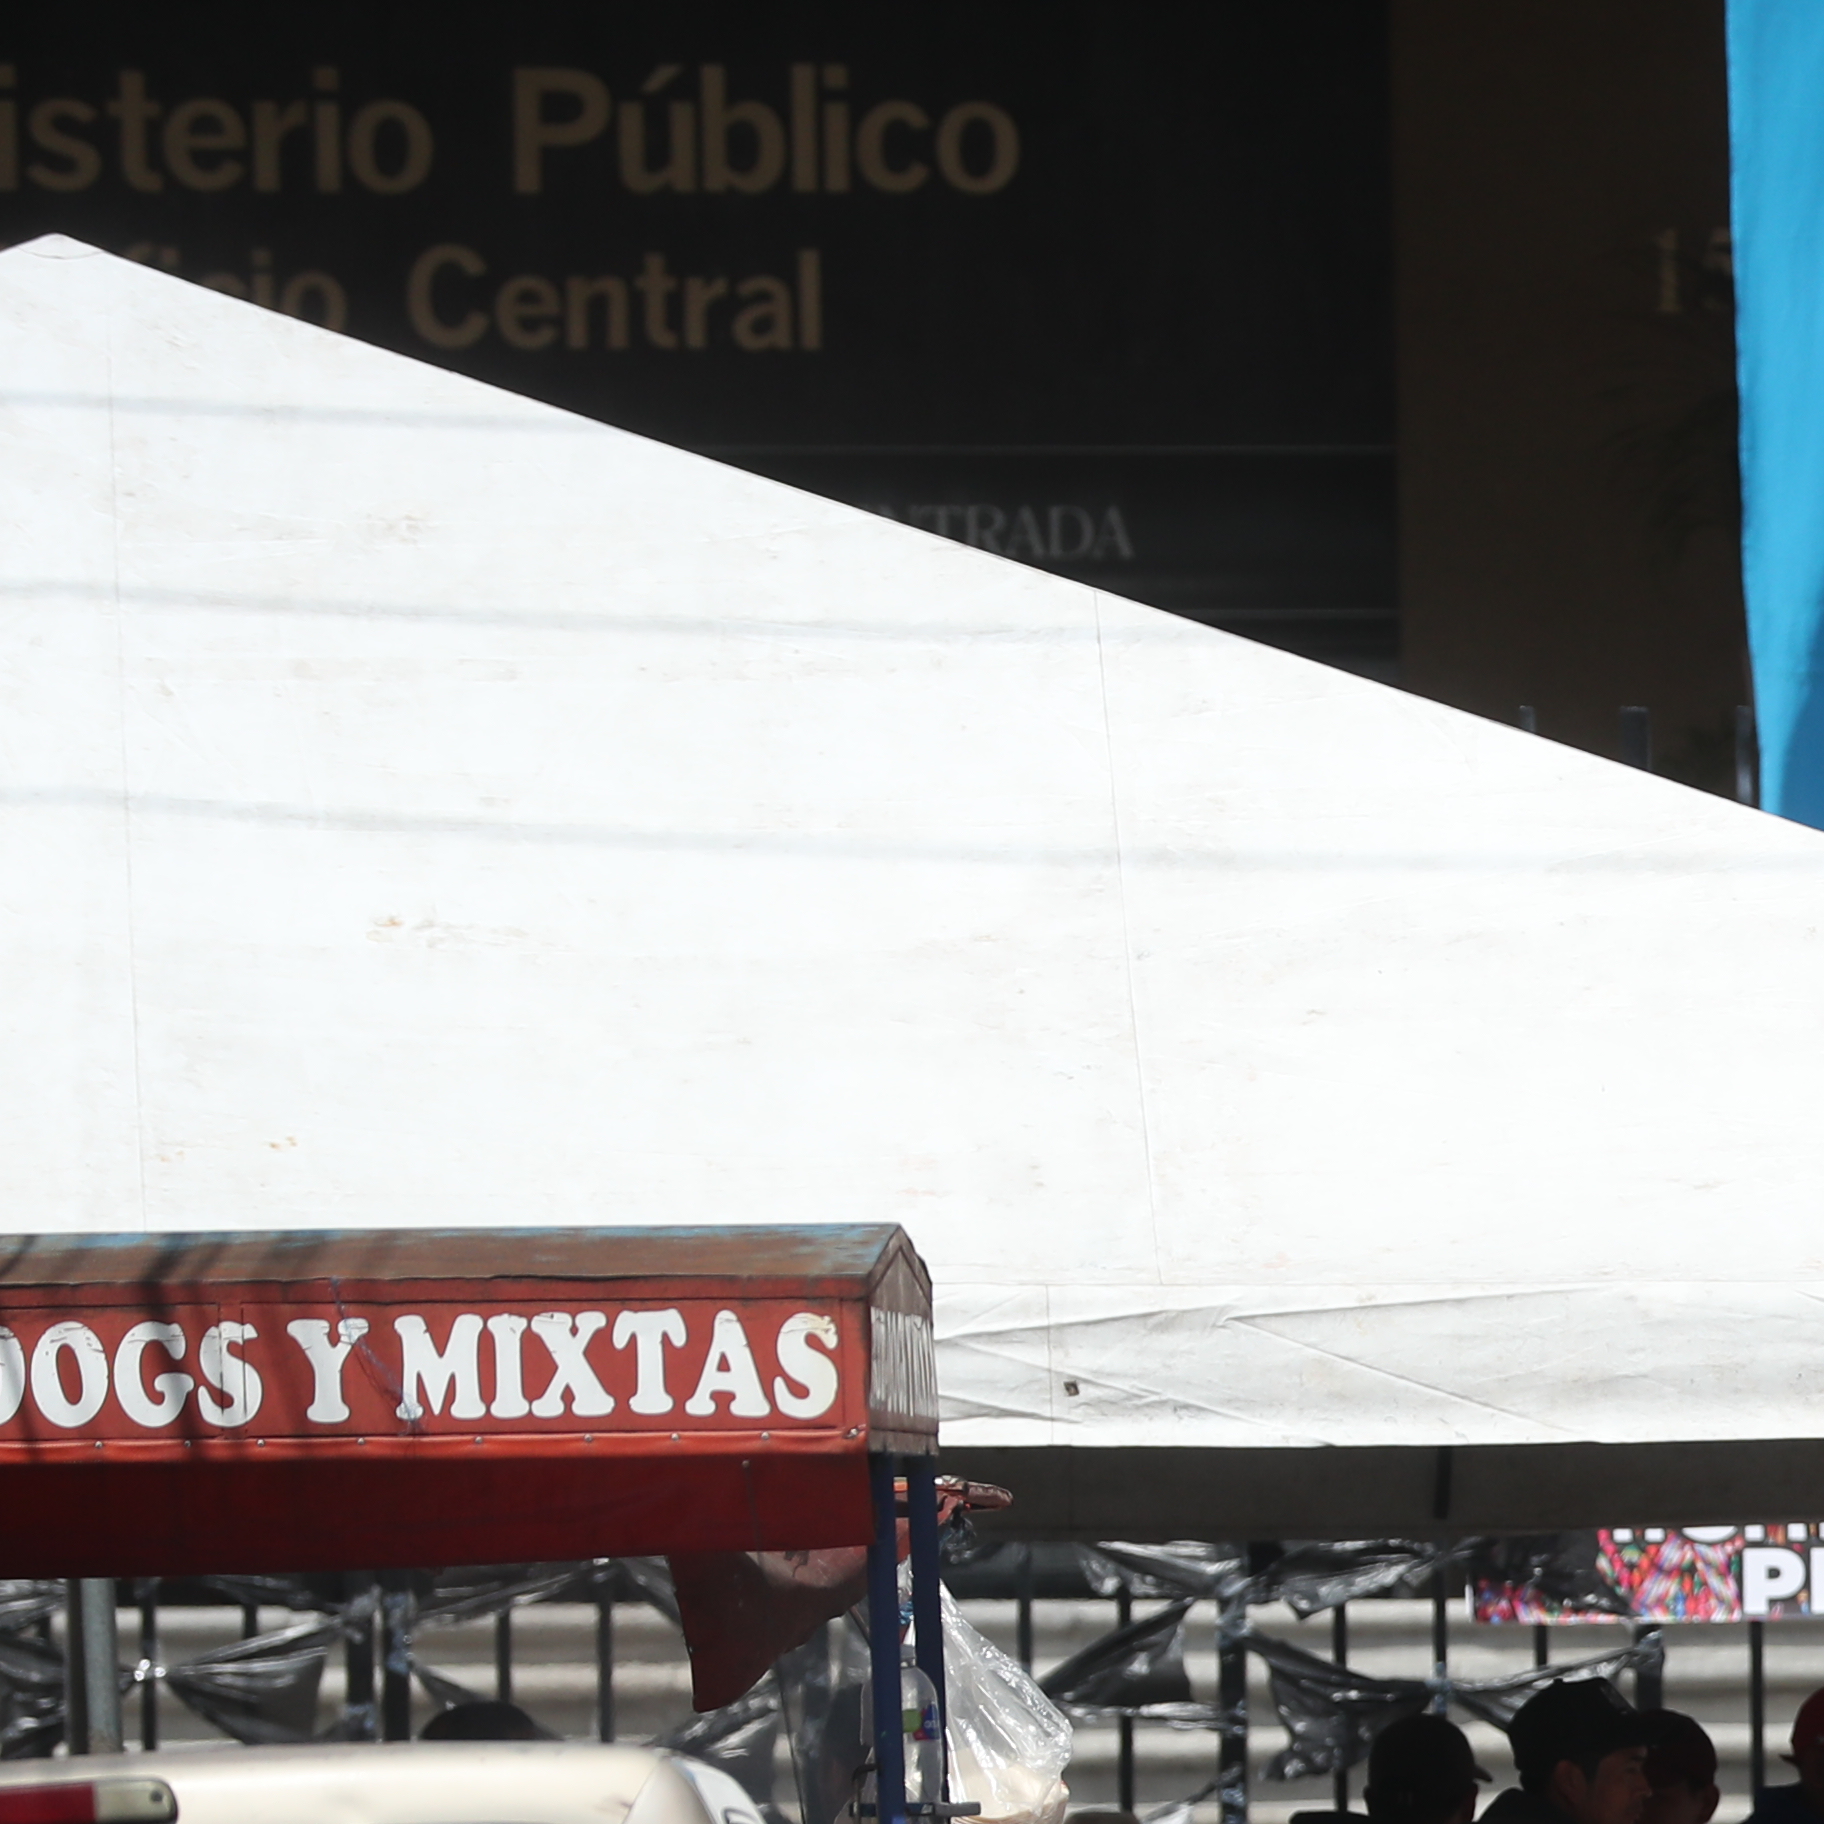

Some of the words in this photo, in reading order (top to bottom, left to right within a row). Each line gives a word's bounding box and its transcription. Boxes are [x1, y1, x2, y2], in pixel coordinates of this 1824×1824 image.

[511, 62, 1021, 196] Público
[406, 244, 822, 351] Central
[286, 1317, 369, 1424] Y
[394, 1308, 839, 1421] MIXTAS
